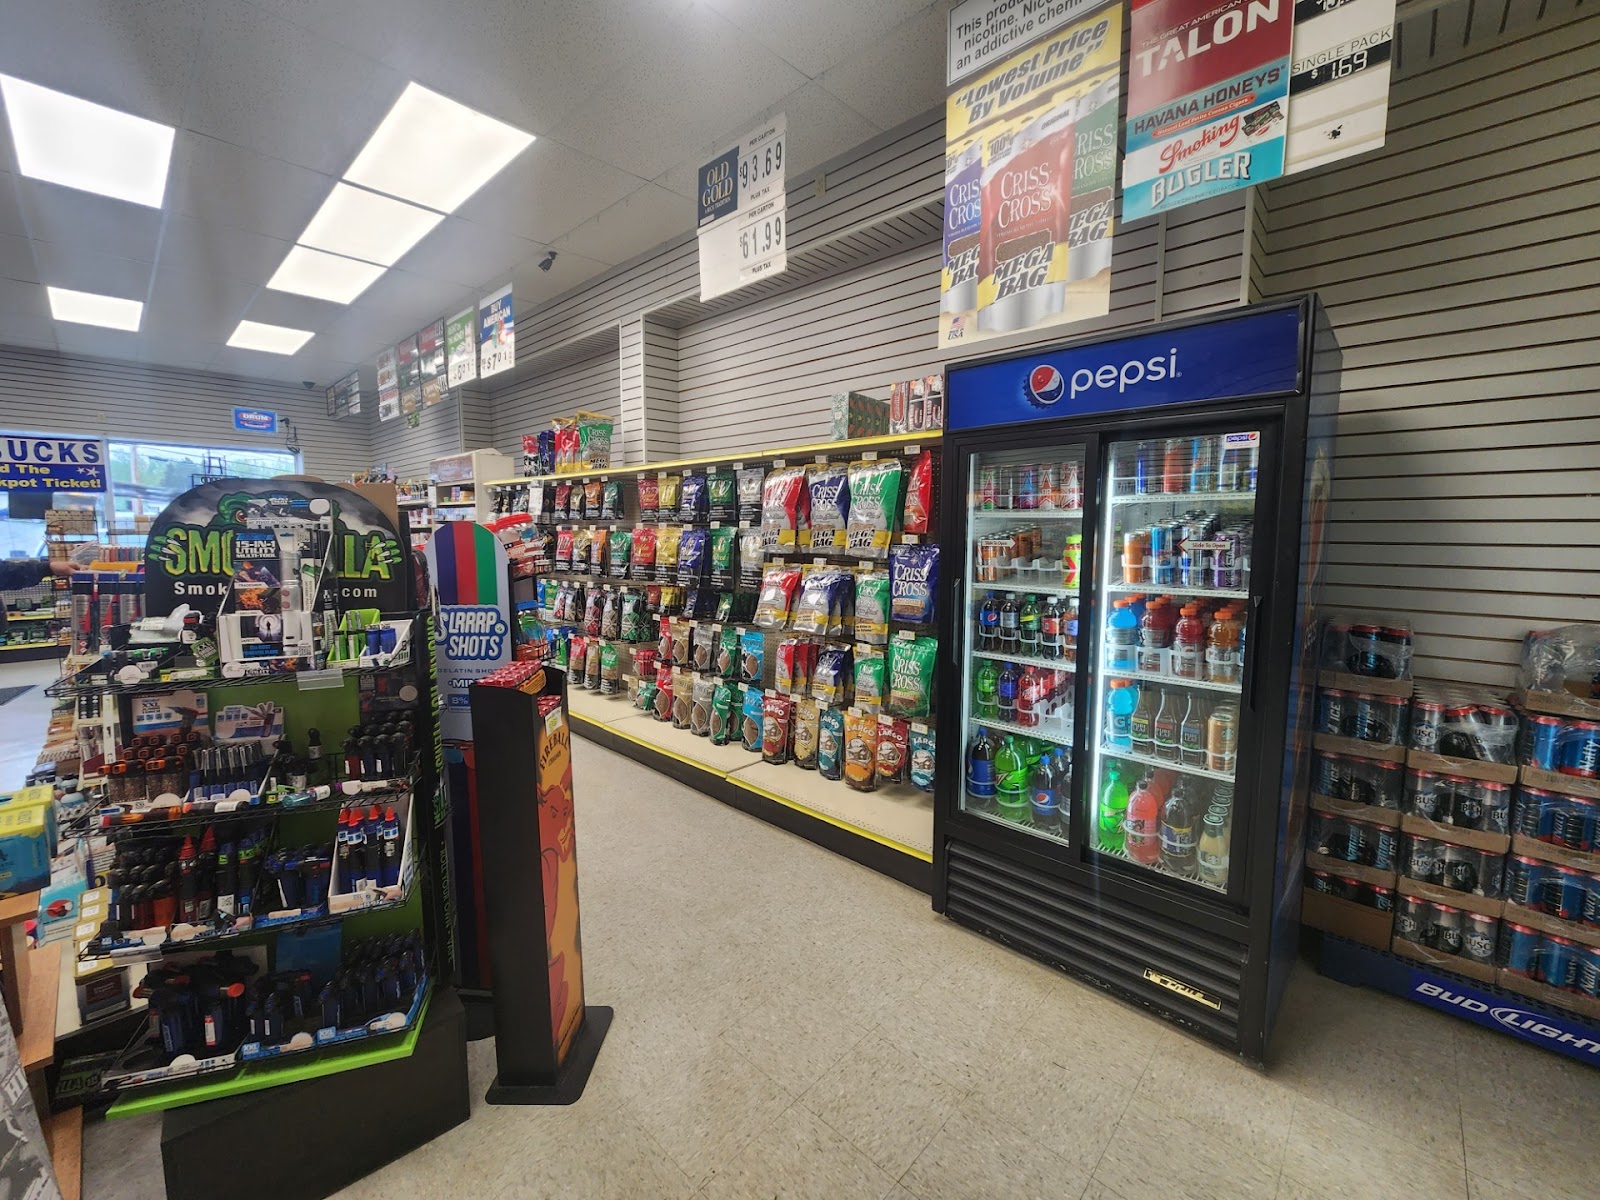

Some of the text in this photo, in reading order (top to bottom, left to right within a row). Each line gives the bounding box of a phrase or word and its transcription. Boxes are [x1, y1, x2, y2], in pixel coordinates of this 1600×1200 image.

[956, 16, 981, 39] This
[964, 15, 1018, 51] nicotine.
[1141, 0, 1243, 48] THE GREAT AMERICAN
[956, 55, 971, 70] an
[975, 19, 1033, 59] addictive
[1043, 19, 1109, 66] Price
[1135, 0, 1279, 77] TALON
[1292, 27, 1391, 74] SINGLE PACK
[1331, 50, 1368, 80] 1.69
[968, 99, 993, 125] By
[1134, 67, 1280, 135] HAVANA HONEYS
[1157, 123, 1178, 136] Natural
[1229, 97, 1249, 111] Cigars
[749, 127, 776, 147] PER CARTON
[1074, 123, 1117, 156] RISS-
[1159, 115, 1240, 174] Smoking
[706, 161, 730, 187] OLD
[1073, 151, 1114, 181] ROSS
[702, 177, 734, 208] GOLD
[1151, 151, 1251, 209] BUGLER
[750, 186, 770, 201] PLUS TAX
[950, 179, 981, 207] CRIS
[748, 201, 775, 219] PER CARTON
[949, 199, 981, 230] CROS
[998, 189, 1051, 229] CROSS
[1070, 199, 1114, 230] EGA
[752, 261, 771, 274] PLUS TAX
[947, 244, 981, 275] MEG
[992, 241, 1055, 286] MEGA
[995, 264, 1049, 302] BAG
[483, 305, 511, 329] AMERICAN
[490, 300, 502, 314] BUY
[1070, 347, 1177, 400] pepsi
[1226, 434, 1248, 442] pepsi
[0, 439, 100, 464] UCKS
[15, 464, 51, 475] The
[42, 478, 102, 488] Ticket!
[812, 484, 838, 498] CRISS
[811, 498, 837, 511] CROSS
[852, 495, 880, 511] CROSS
[235, 540, 276, 548] 15-IN-1
[761, 537, 777, 547] BAG
[813, 538, 833, 548] BAG
[849, 537, 872, 549] BAG
[894, 561, 927, 581] CRISS
[892, 580, 928, 598] CROSS
[448, 635, 500, 657] SHOTS
[891, 671, 921, 691] CROSS
[820, 714, 841, 730] LARGO
[1331, 702, 1341, 721] ICE
[846, 724, 876, 737] LARGO
[878, 728, 903, 742] LARGO
[539, 731, 569, 771] FIREBALL
[1579, 739, 1600, 772] Natty
[1330, 764, 1340, 782] ICE
[1415, 982, 1489, 1014] BUD
